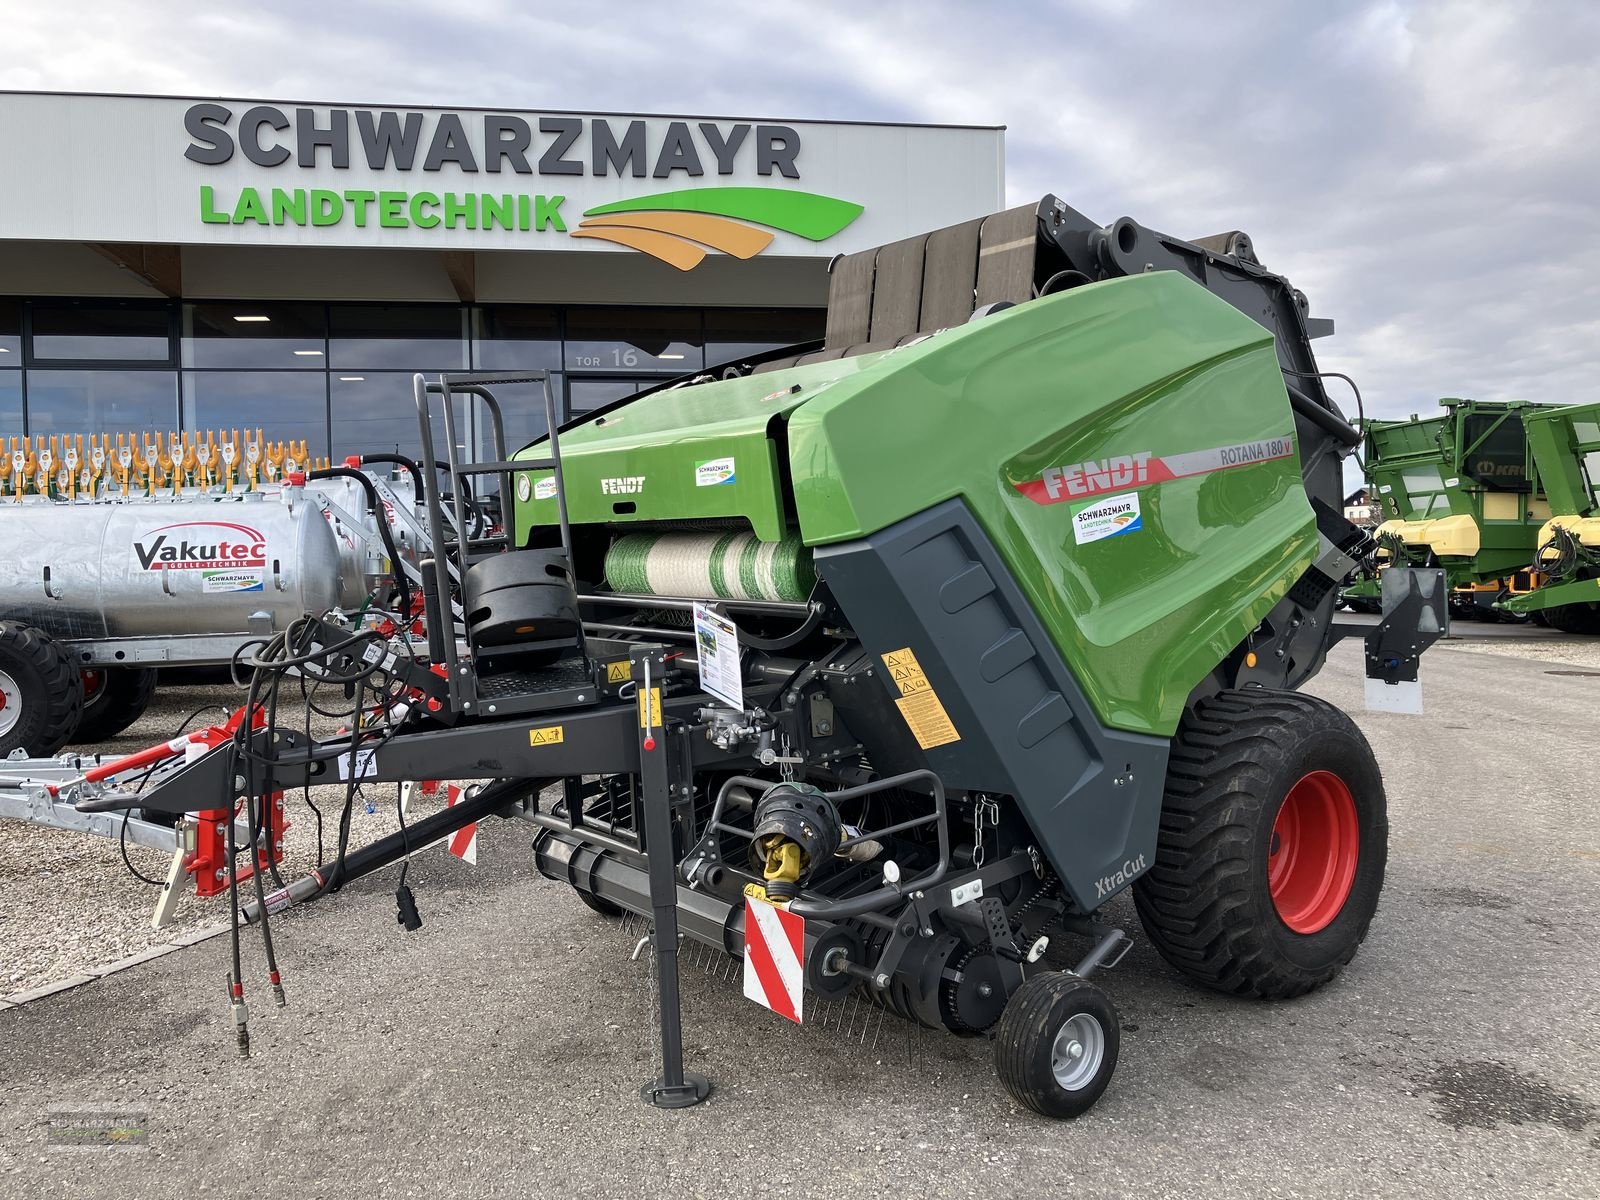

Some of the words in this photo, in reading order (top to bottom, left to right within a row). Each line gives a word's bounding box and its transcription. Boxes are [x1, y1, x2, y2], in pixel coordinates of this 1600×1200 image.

[184, 103, 801, 179] SCHWARZMAYR
[200, 185, 567, 232] LANDTECHNIK
[575, 356, 601, 366] TOR
[612, 348, 638, 367] 16
[1220, 443, 1265, 466] ROTANA
[1265, 440, 1284, 457] 180
[601, 476, 646, 495] FENDT
[1042, 452, 1151, 499] FENDT
[1078, 503, 1131, 523] SCHWARZMAYR
[134, 535, 267, 570] Vakutec
[1095, 854, 1146, 898] XtraCut
